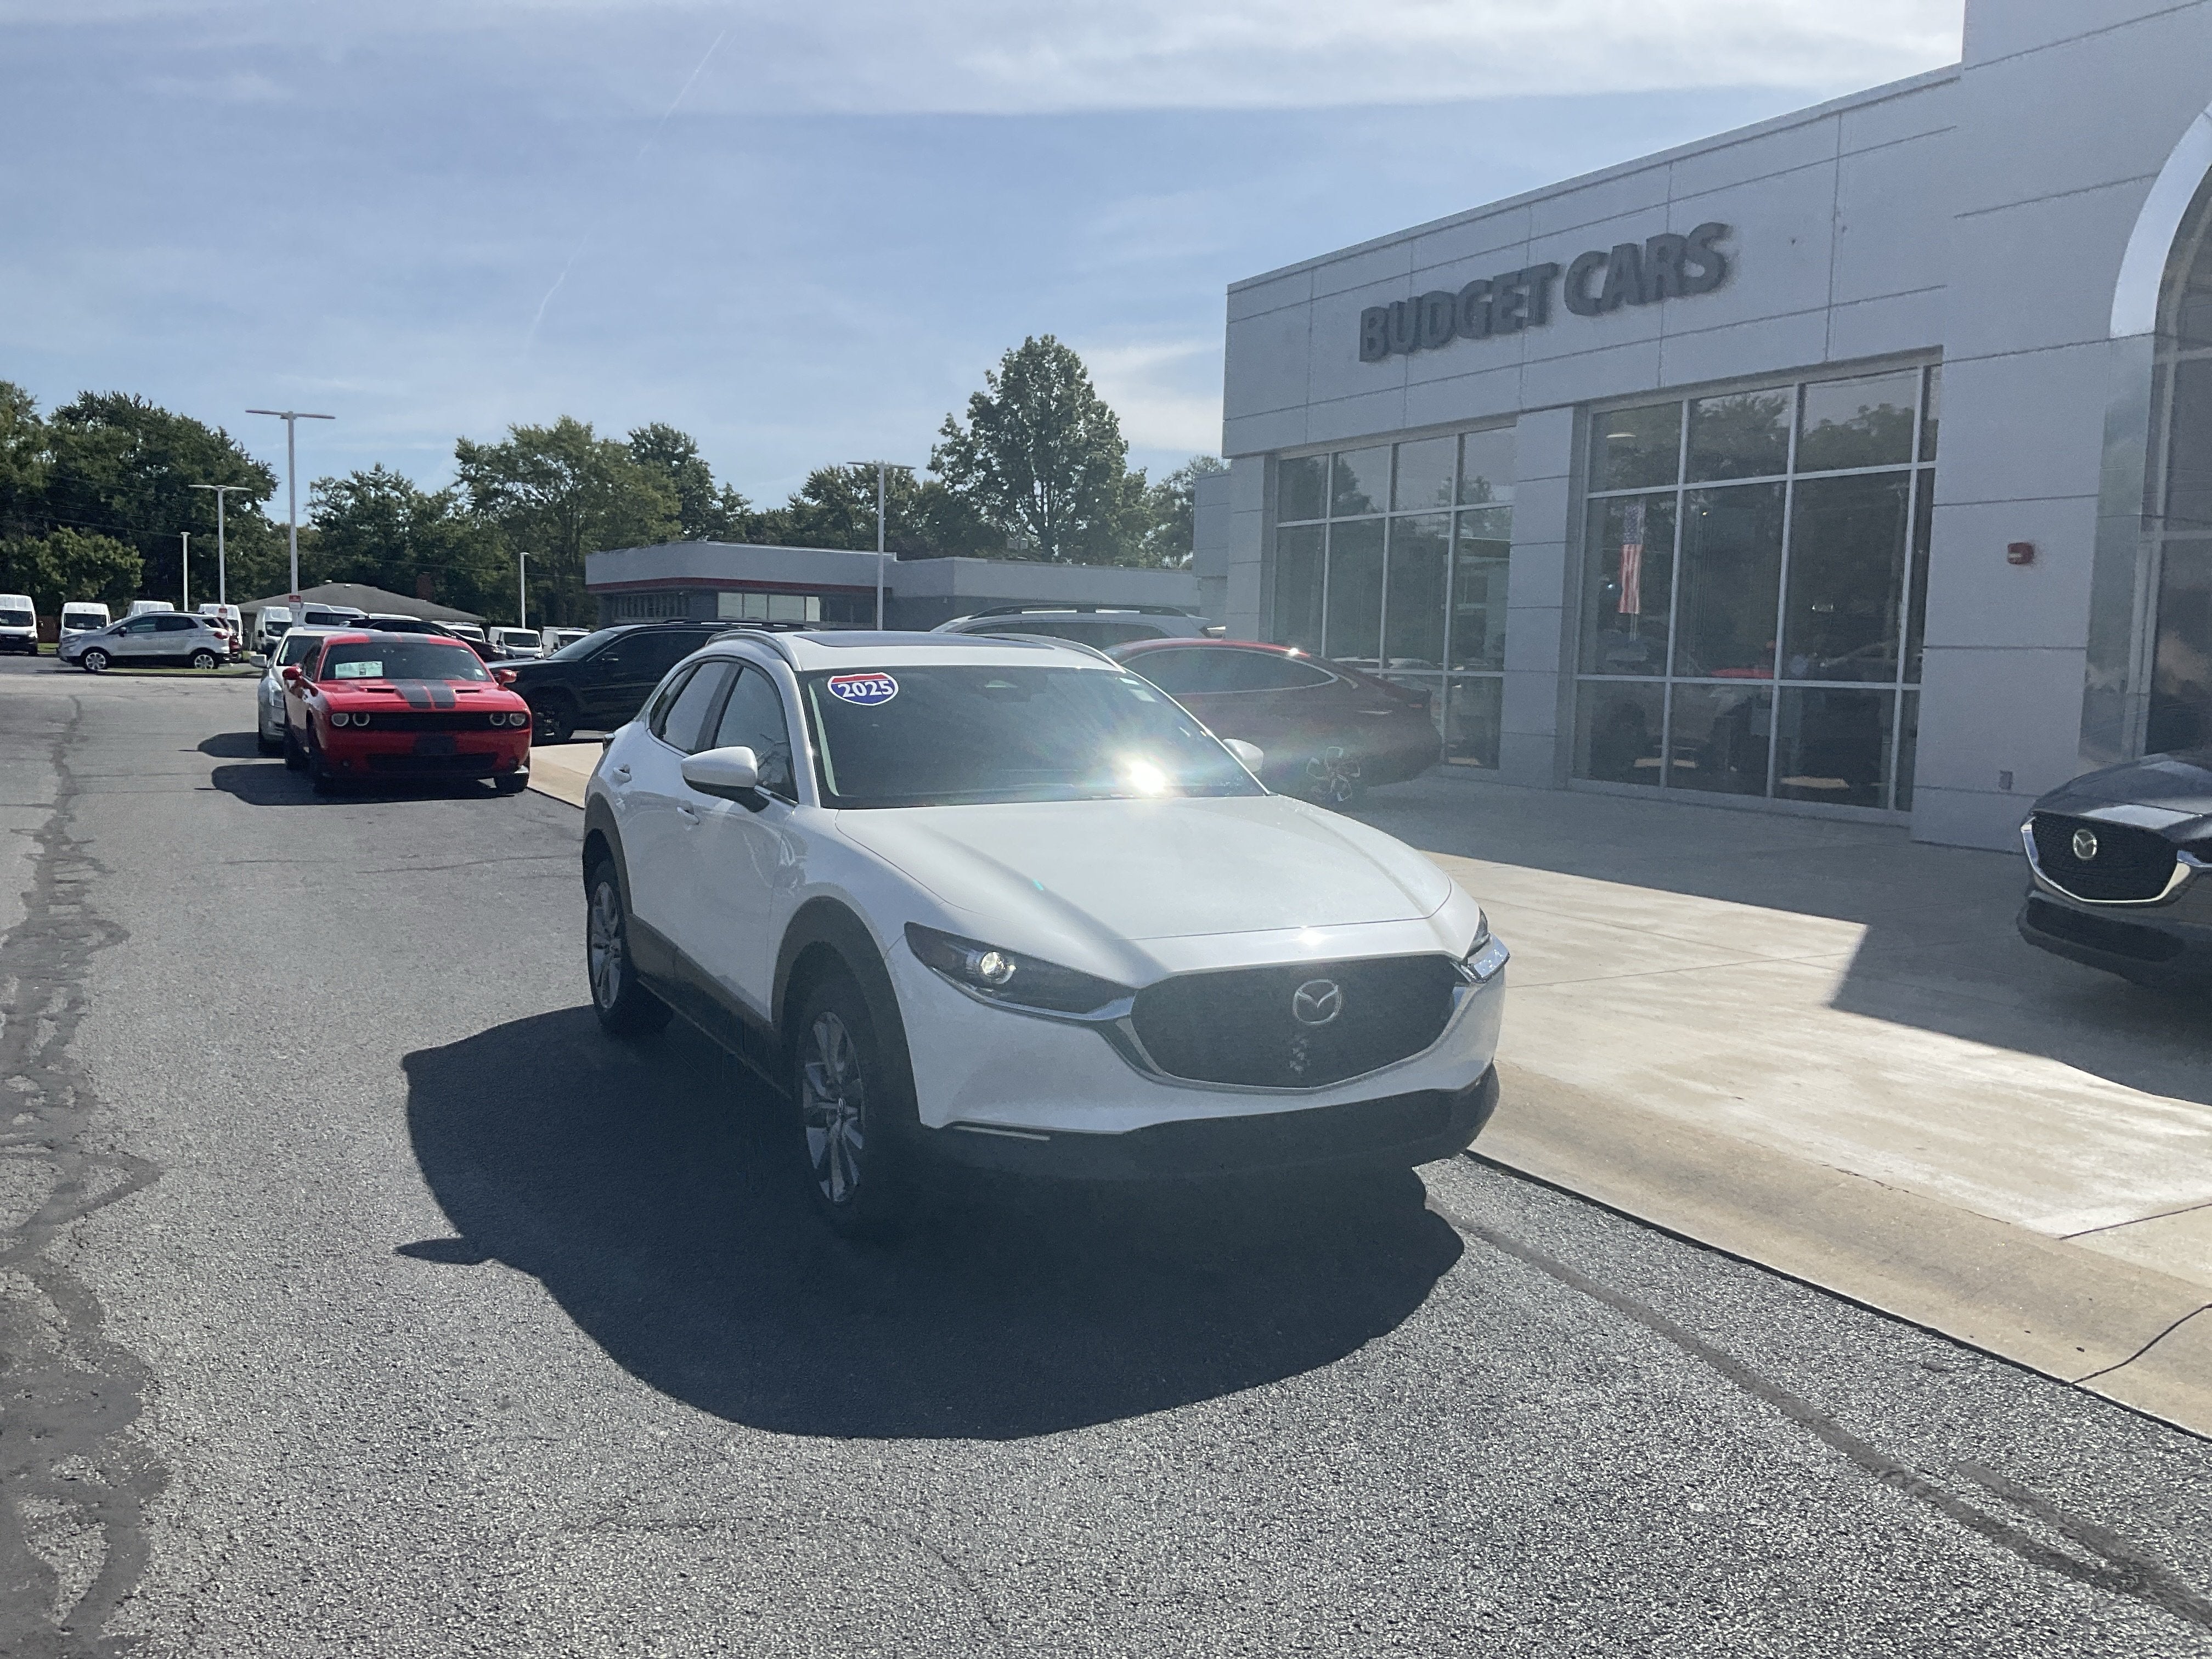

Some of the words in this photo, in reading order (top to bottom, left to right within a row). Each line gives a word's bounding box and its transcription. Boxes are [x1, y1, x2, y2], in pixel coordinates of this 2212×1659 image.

[1359, 262, 1561, 362] BUDGET
[1564, 222, 1733, 317] CARS
[838, 680, 893, 697] 2025
